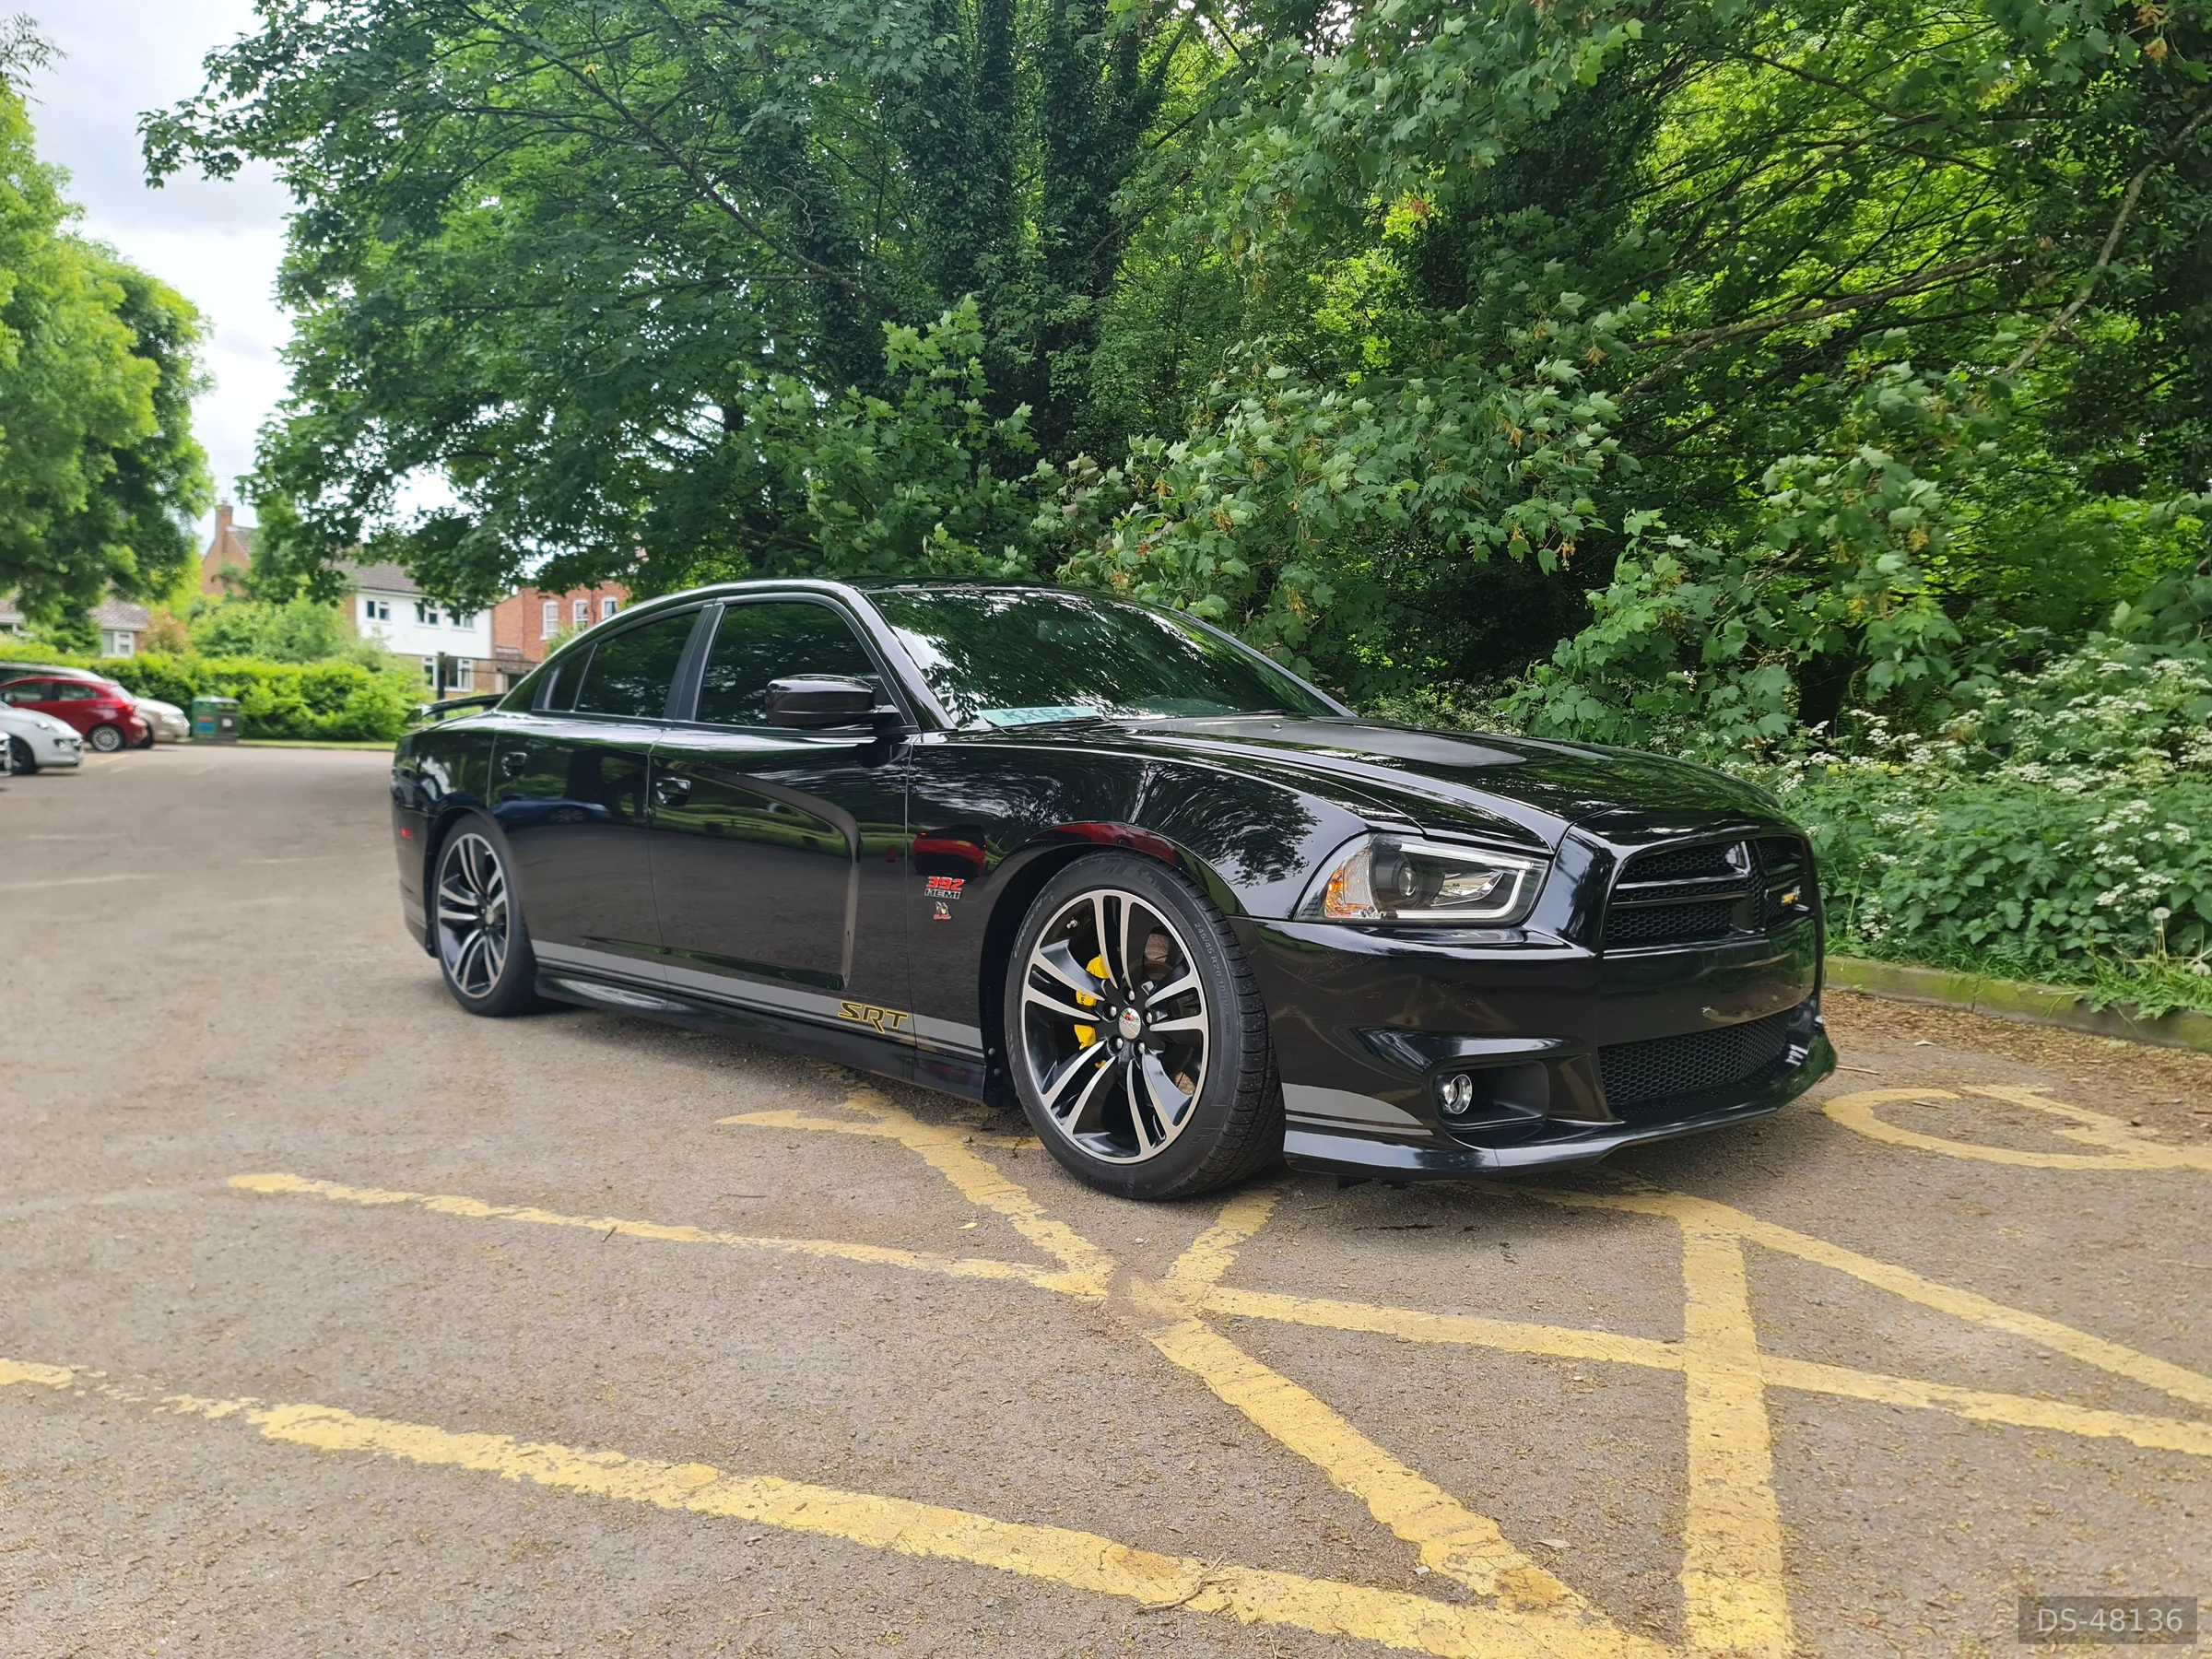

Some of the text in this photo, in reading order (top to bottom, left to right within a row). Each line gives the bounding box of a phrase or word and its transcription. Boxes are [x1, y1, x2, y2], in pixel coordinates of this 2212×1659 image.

[924, 888, 961, 900] HEMI
[925, 876, 965, 891] 392
[1194, 922, 1214, 955] 245/45
[1210, 957, 1222, 977] R20
[838, 1000, 910, 1034] SRT
